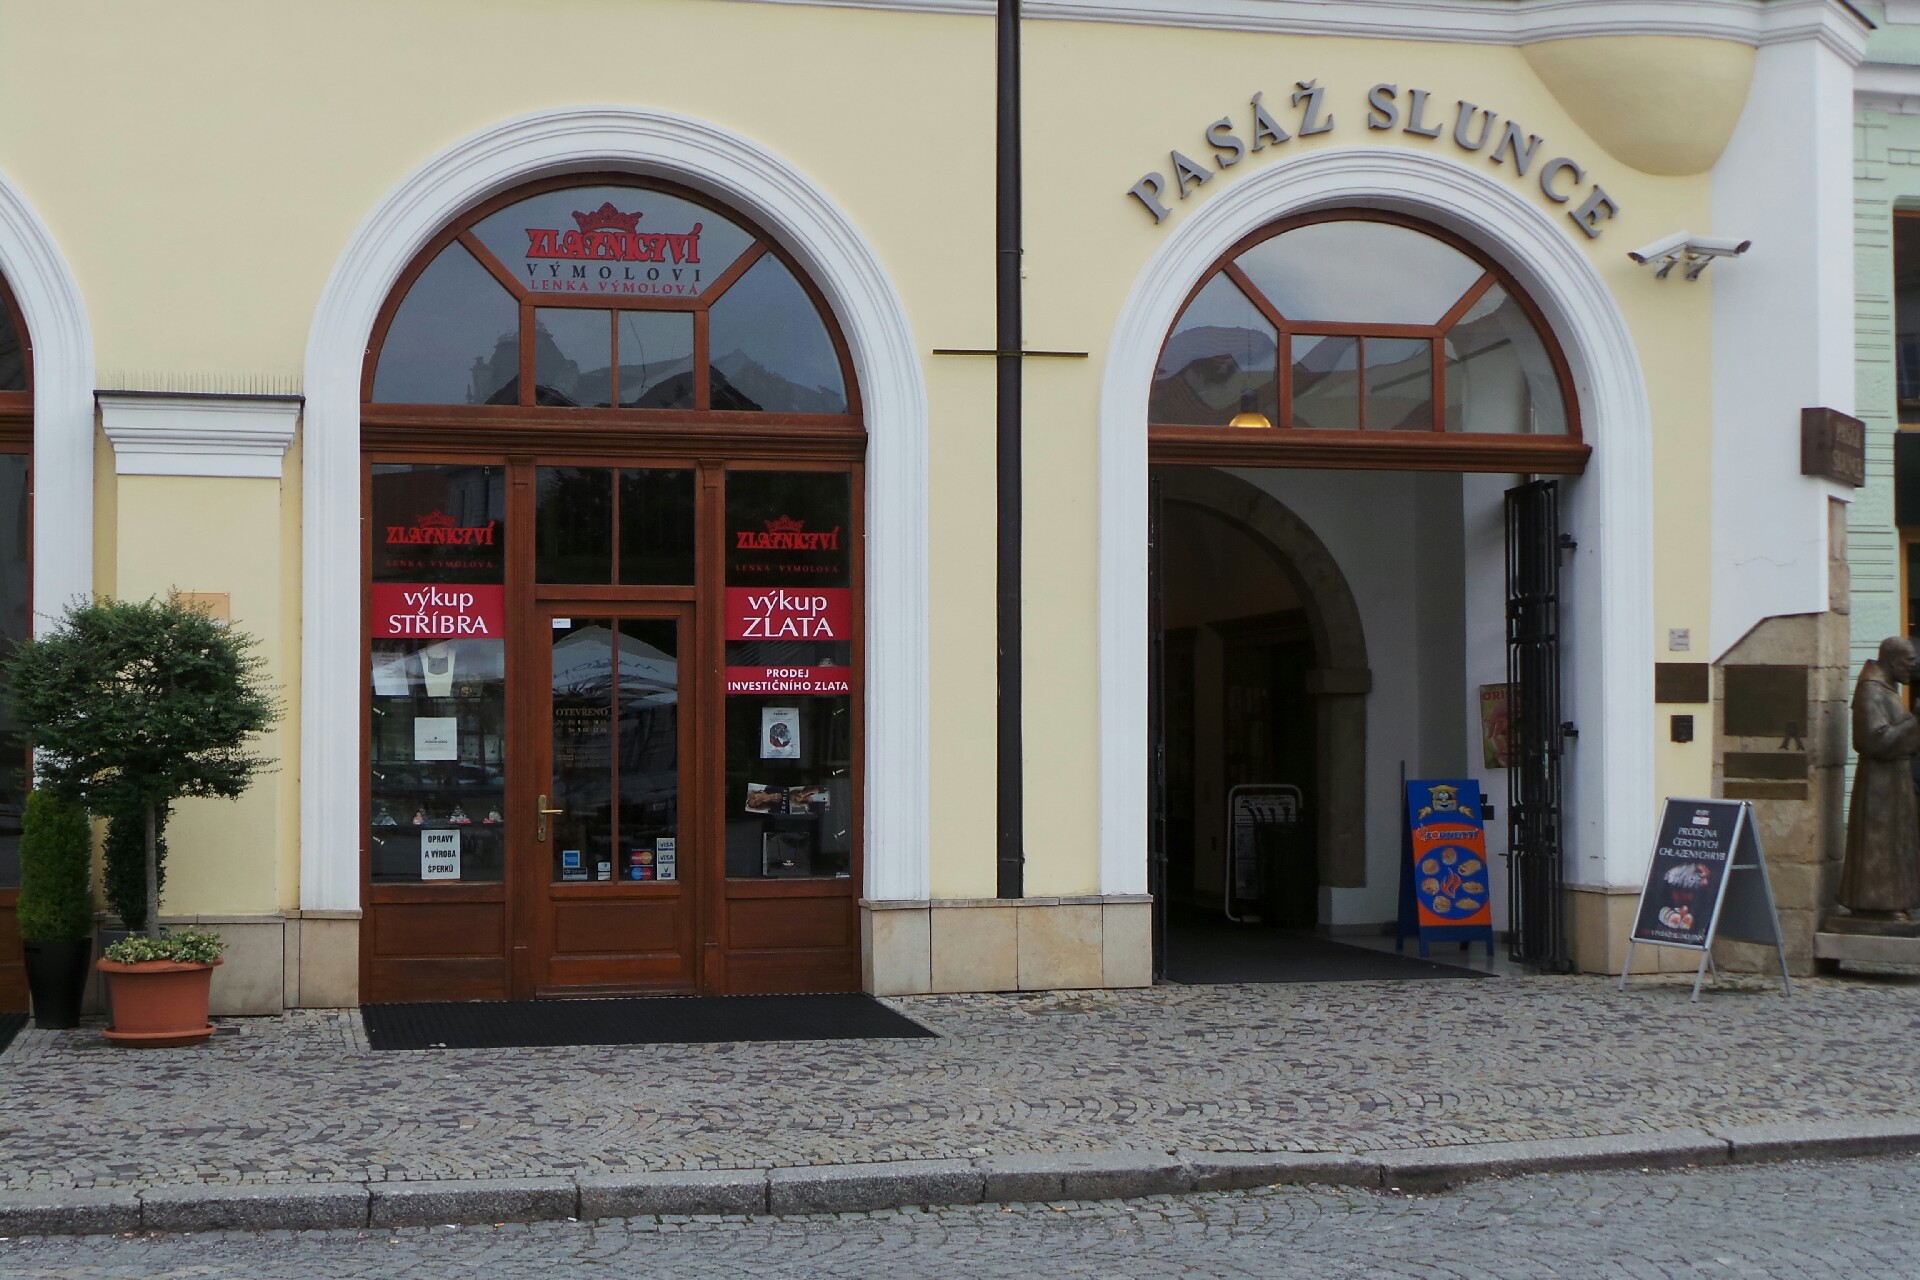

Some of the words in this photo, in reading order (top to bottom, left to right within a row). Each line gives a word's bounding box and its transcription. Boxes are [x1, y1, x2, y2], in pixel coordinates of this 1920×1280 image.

[1127, 78, 1334, 225] PASÁŽ
[1367, 83, 1621, 239] SLUNCE
[525, 222, 703, 264] ZLATNICTVÍ
[527, 261, 700, 282] VÝMOLOVI
[531, 279, 589, 291] LENKA
[600, 280, 698, 295] VÝMOLOVÁ
[403, 586, 474, 613] výkup
[747, 589, 828, 617] výkup
[389, 611, 489, 634] STŘÍBRA
[742, 617, 834, 637] ZLATA
[766, 669, 809, 678] PRODEJ
[728, 679, 812, 691] INVESTIČNÍHO
[814, 681, 849, 691] ZLATA
[427, 835, 454, 843] OPRAVY
[1425, 830, 1478, 840] FORNETTI
[1678, 827, 1718, 839] PRODEJNA
[424, 850, 430, 858] A
[431, 849, 457, 858] VÝROBA
